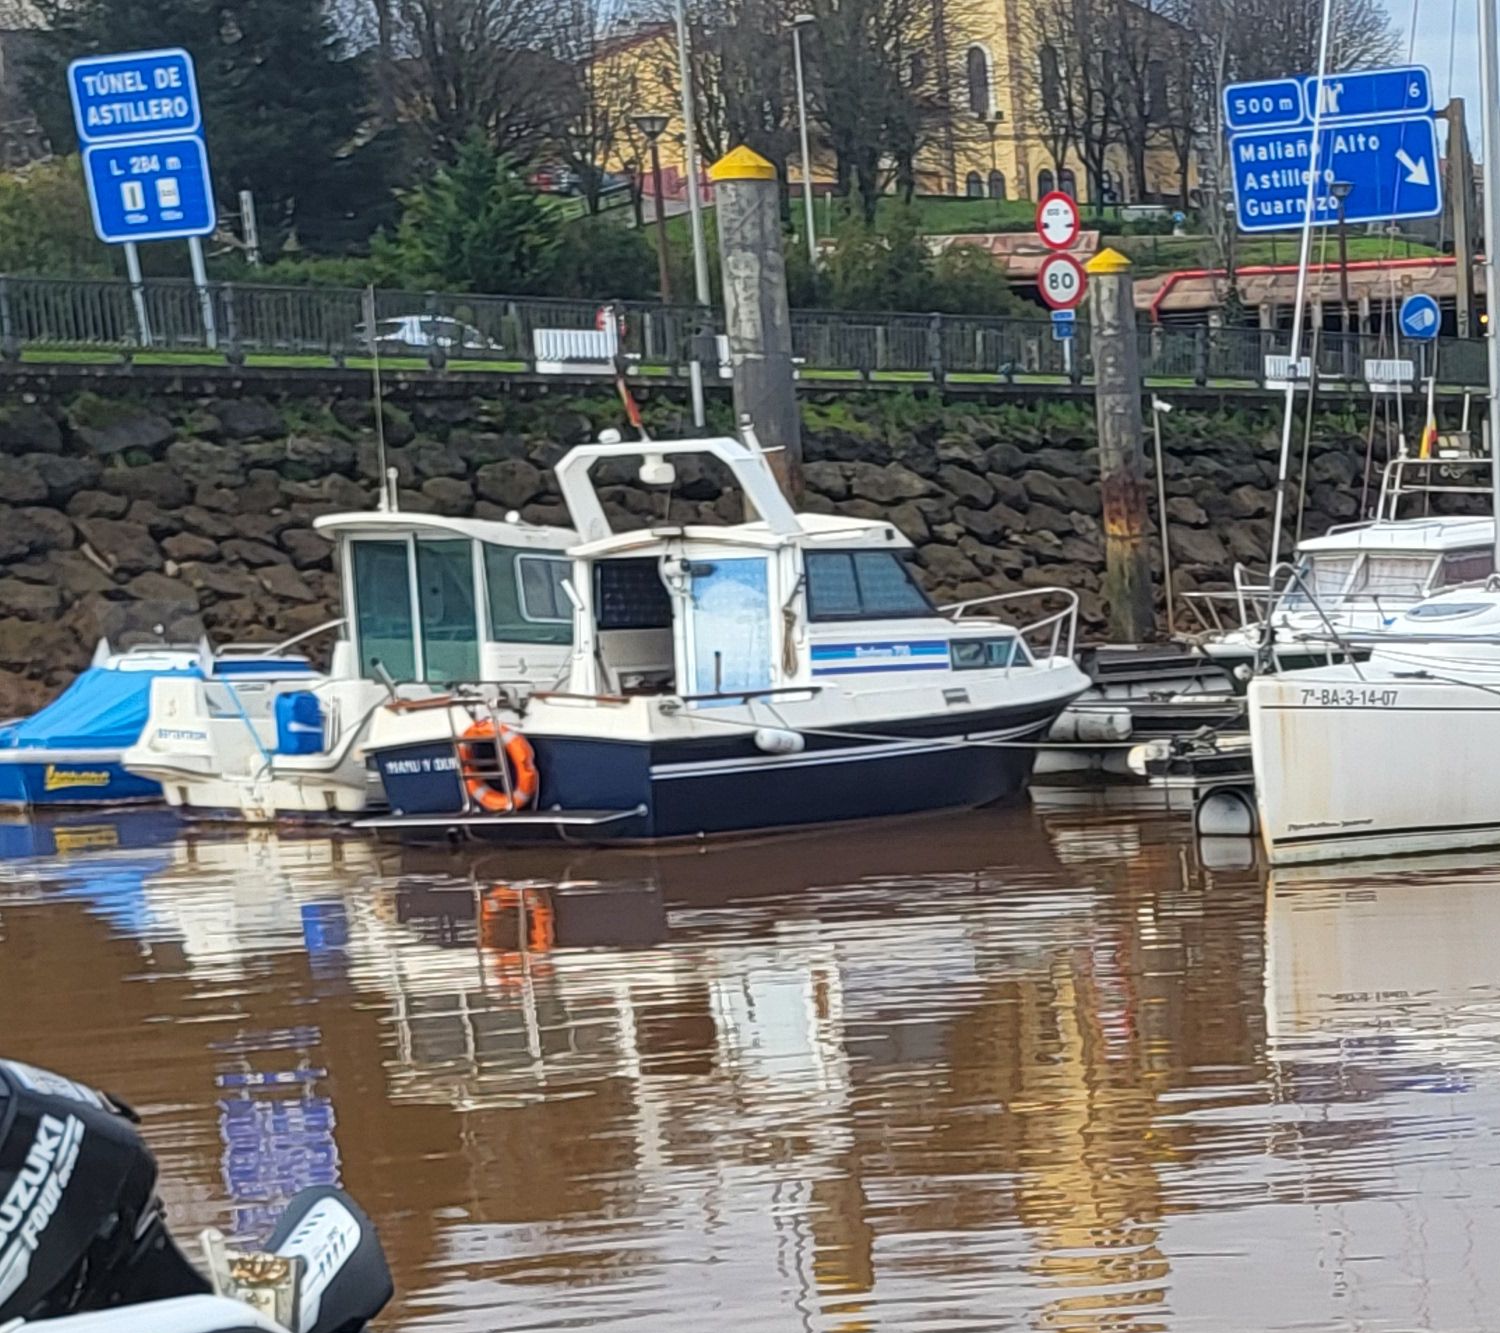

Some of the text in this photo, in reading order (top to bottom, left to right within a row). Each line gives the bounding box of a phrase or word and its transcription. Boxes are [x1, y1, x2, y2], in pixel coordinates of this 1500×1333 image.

[83, 67, 182, 96] TÚNEL DE
[1408, 82, 1421, 98] 6
[87, 96, 189, 127] ASTILLERO
[1234, 97, 1293, 115] 500 m
[1334, 133, 1380, 154] Alto
[110, 159, 125, 176] L
[1244, 168, 1335, 191] Astillero
[1049, 272, 1075, 290] 80
